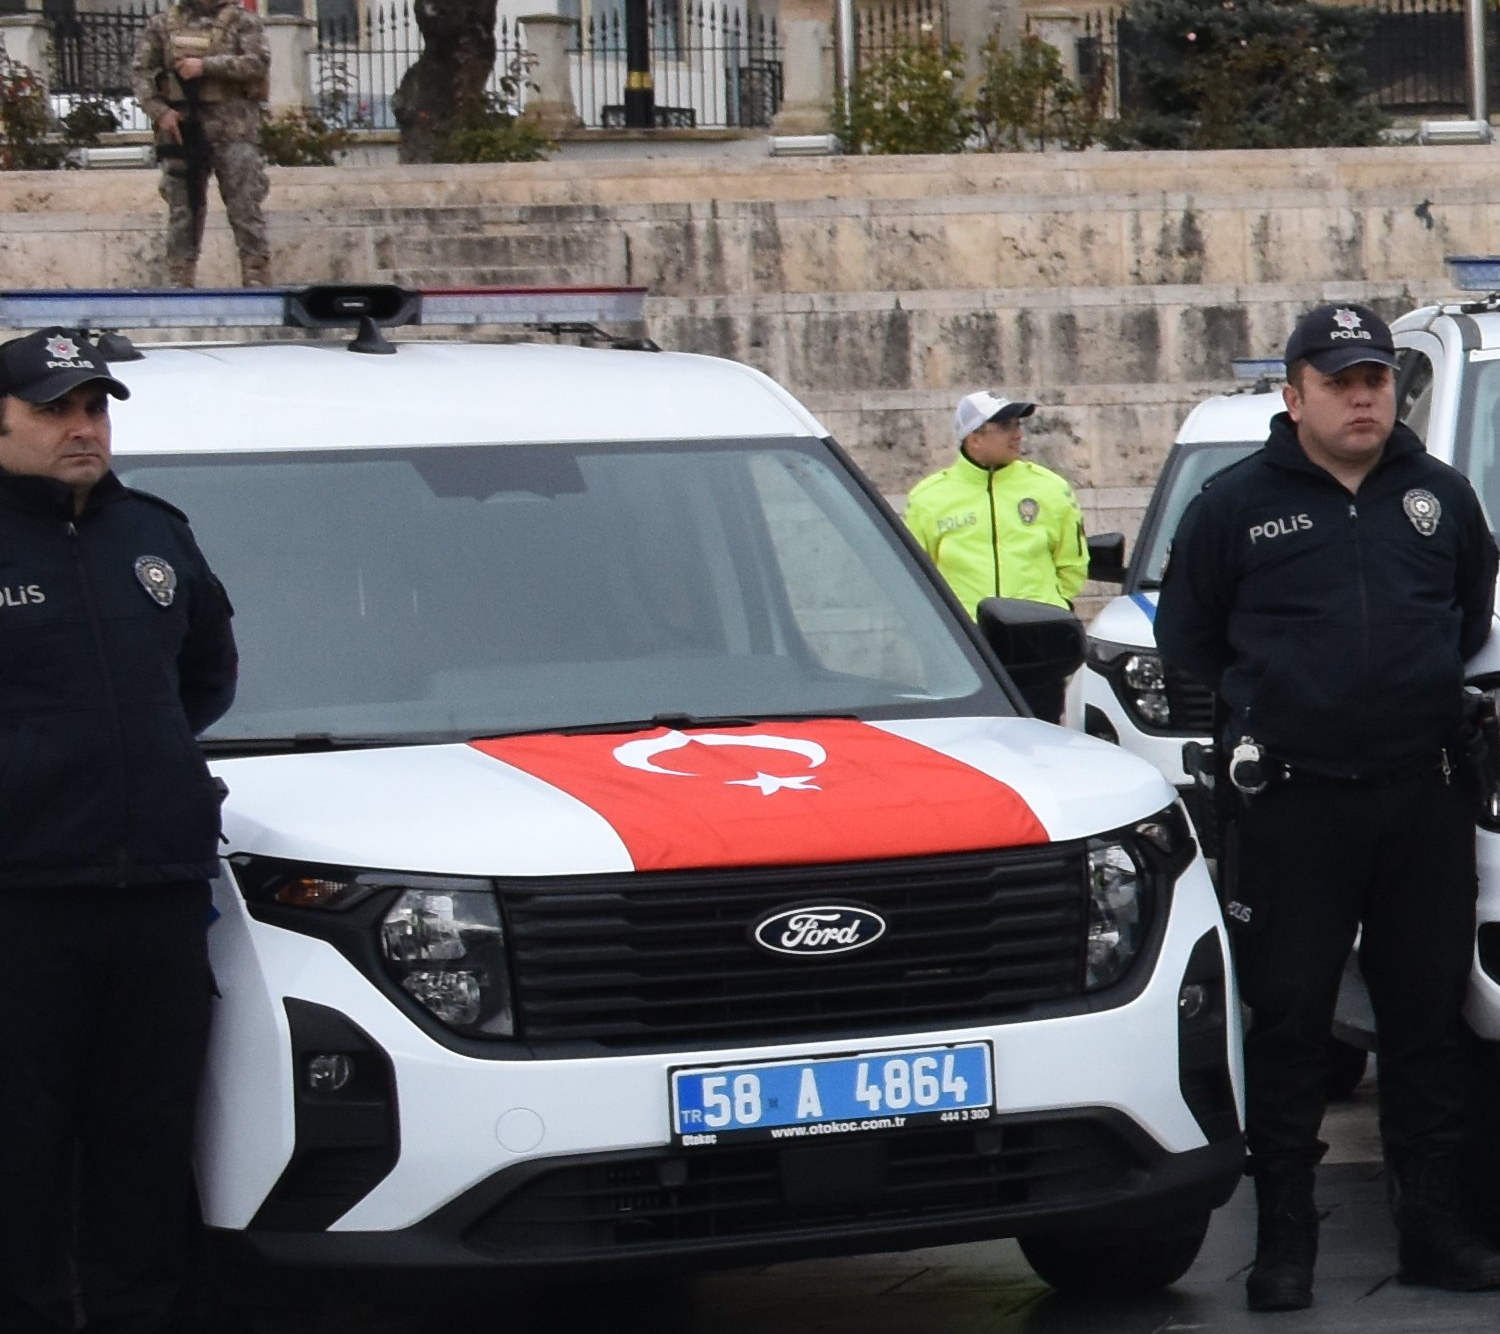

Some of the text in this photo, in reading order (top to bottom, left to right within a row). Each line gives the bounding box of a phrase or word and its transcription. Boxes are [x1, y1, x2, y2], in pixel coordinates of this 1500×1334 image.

[781, 913, 862, 948] Ford
[702, 1054, 968, 1127] 58 A 4864
[681, 1110, 703, 1124] TR
[770, 1116, 907, 1140] www.otokoc.com.tr
[940, 1112, 960, 1122] 444
[961, 1110, 969, 1121] 3
